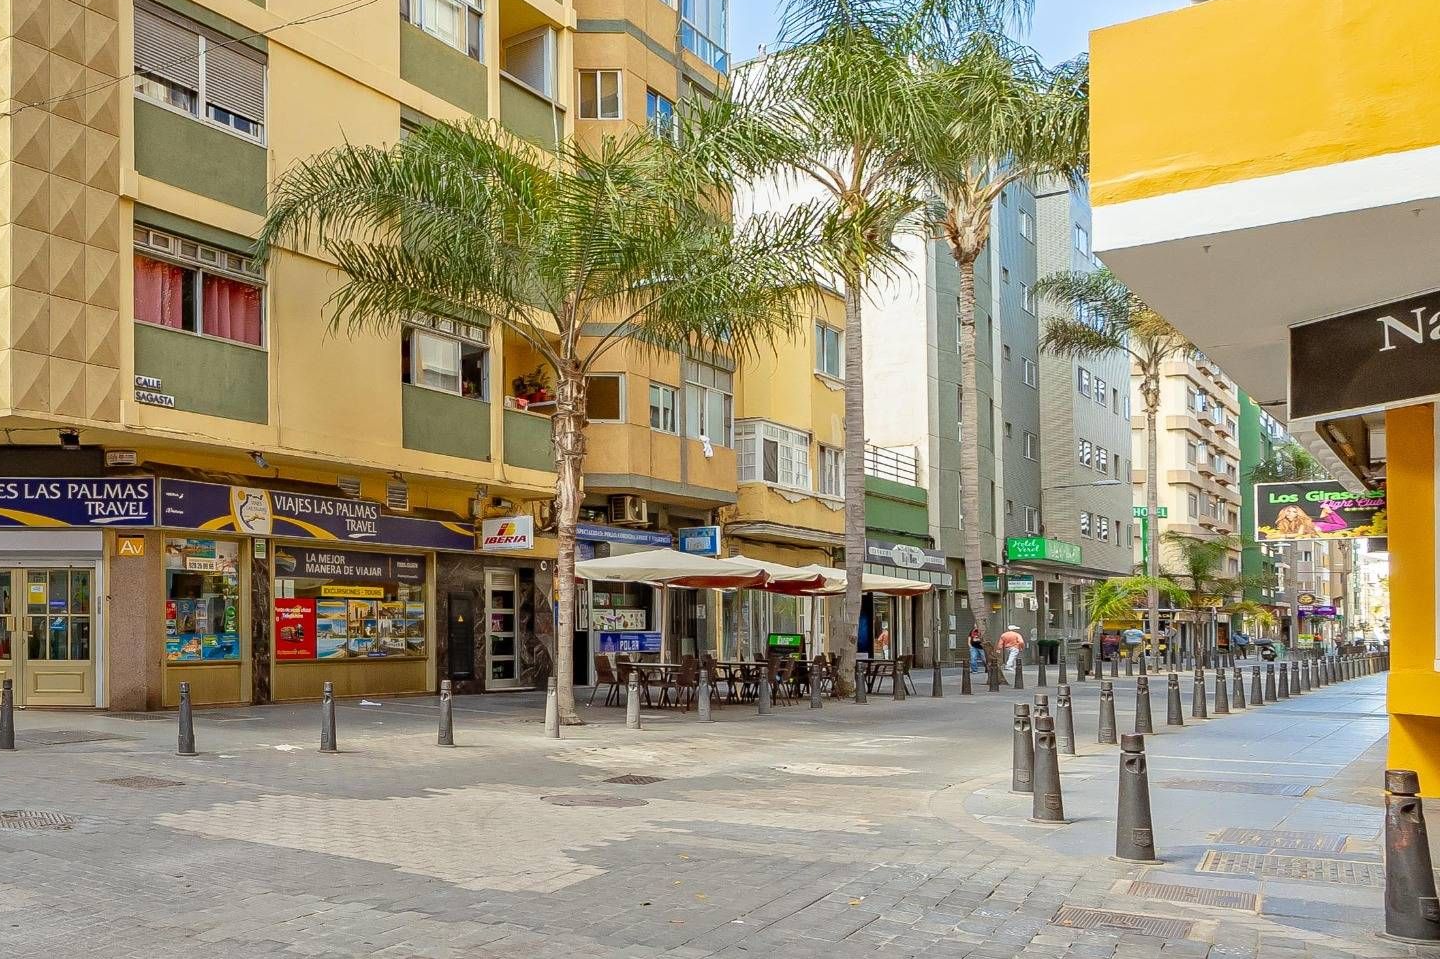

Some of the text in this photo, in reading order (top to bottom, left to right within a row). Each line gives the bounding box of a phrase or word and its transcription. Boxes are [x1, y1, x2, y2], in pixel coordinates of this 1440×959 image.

[136, 377, 161, 388] CALLE
[136, 392, 173, 406] SAGASTA
[24, 483, 60, 499] LAS
[67, 483, 149, 499] PALMAS
[1269, 493, 1298, 504] Los
[85, 501, 149, 516] TRAVEL
[274, 496, 377, 520] VIAJES LAS PALMAS
[1133, 507, 1167, 517] HOEL
[345, 519, 378, 533] TRAVEL
[484, 535, 527, 545] IBERIA
[120, 541, 143, 554] Av
[305, 553, 346, 564] LA MEJOR
[305, 563, 382, 577] MANERA DE VIAJAR
